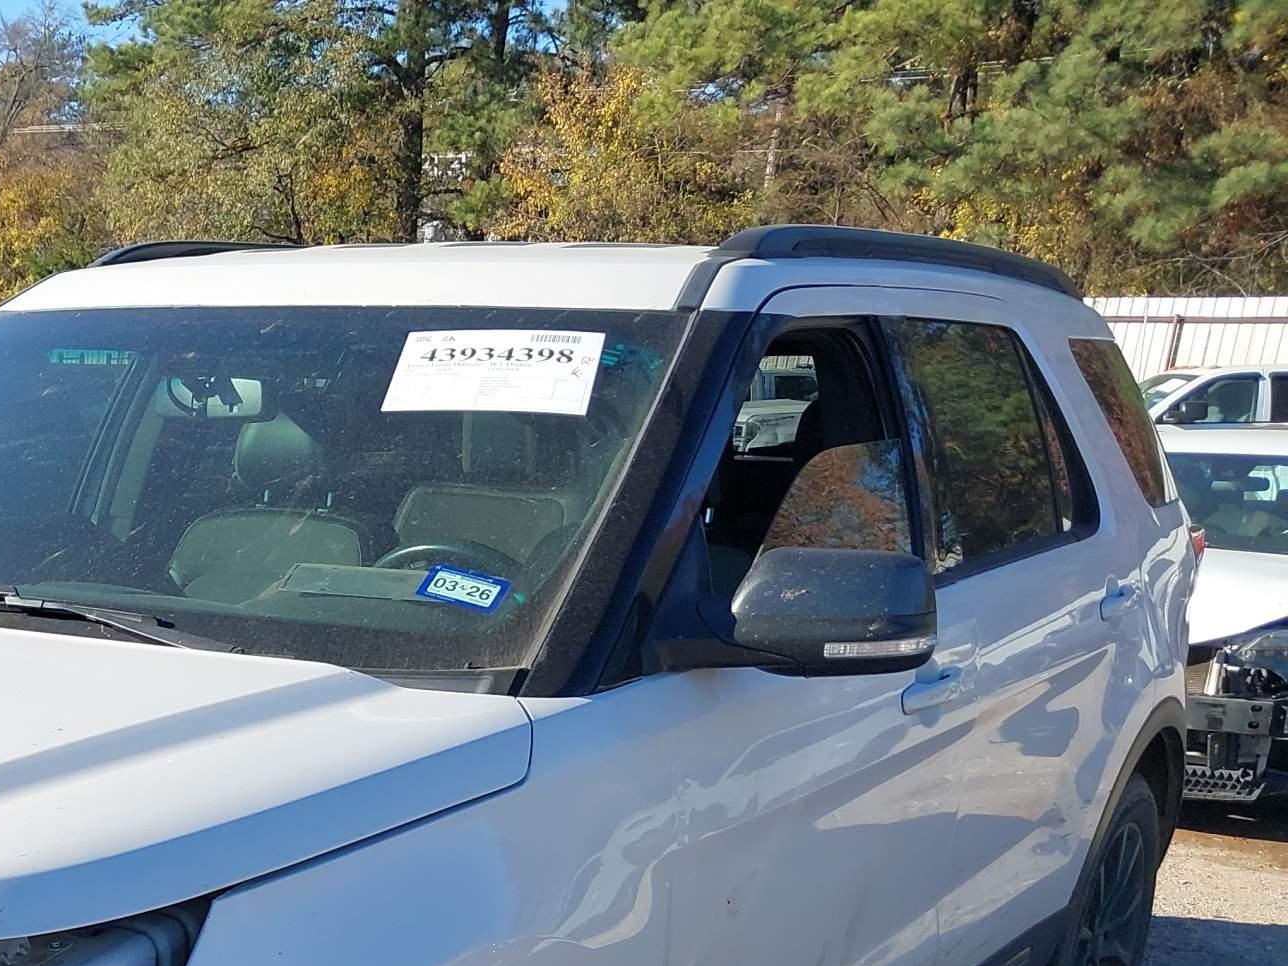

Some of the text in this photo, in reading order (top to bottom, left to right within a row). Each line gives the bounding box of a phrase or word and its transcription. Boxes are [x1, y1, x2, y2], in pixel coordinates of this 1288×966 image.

[419, 347, 576, 364] 43934398
[433, 577, 459, 592] 03
[465, 586, 493, 601] 26
